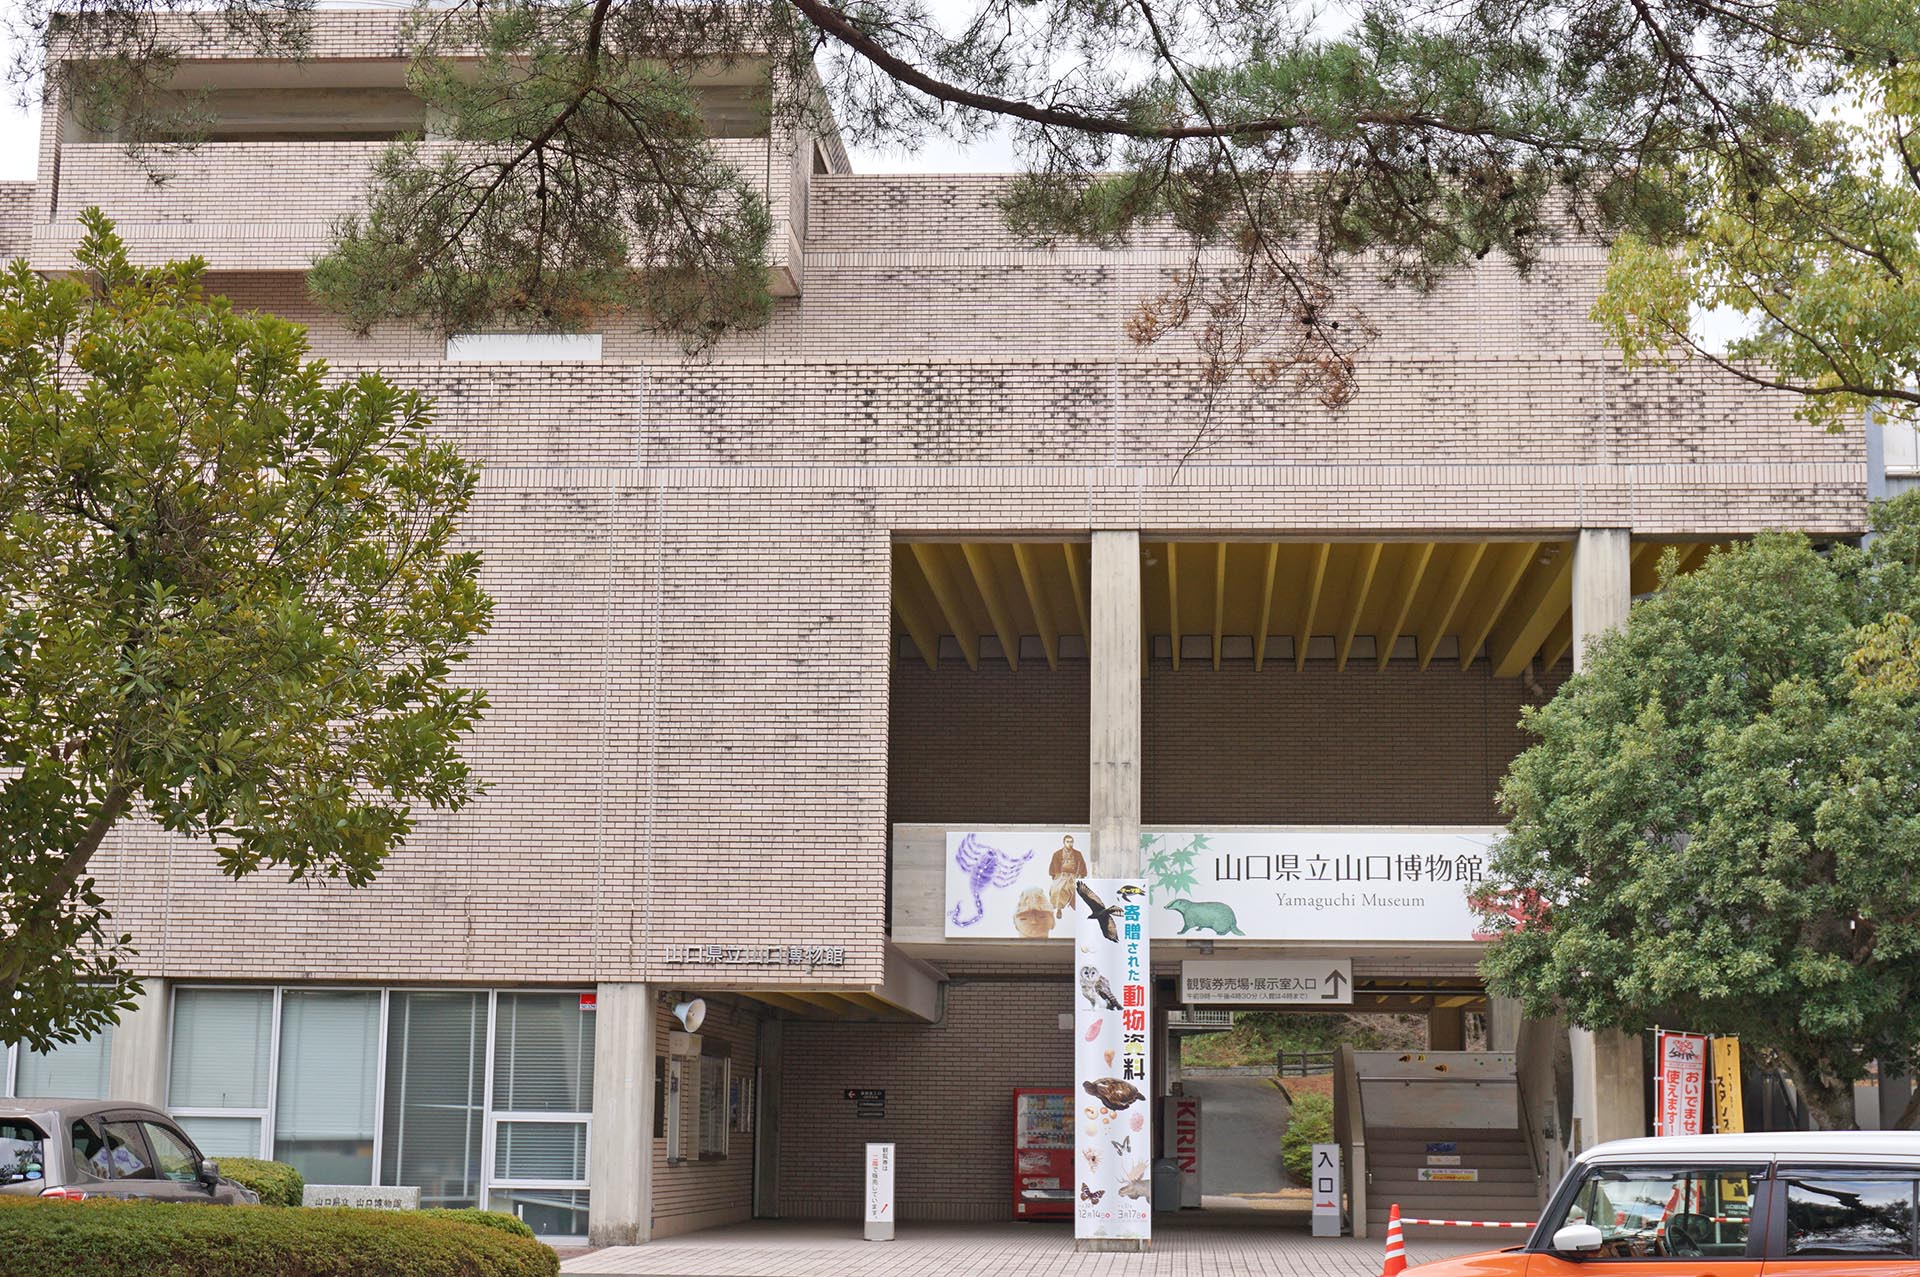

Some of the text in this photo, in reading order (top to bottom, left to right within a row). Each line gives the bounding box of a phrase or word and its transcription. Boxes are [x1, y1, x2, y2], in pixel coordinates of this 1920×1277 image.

[1215, 854, 1482, 882] 山口県立山口博物館
[1276, 893, 1425, 910] Yamaguchi Museum
[665, 944, 845, 965] 山口県立山口博物館
[1683, 1071, 1699, 1135] おいでませ
[1177, 1101, 1196, 1173] KIRIN
[1318, 1152, 1333, 1193] 入口
